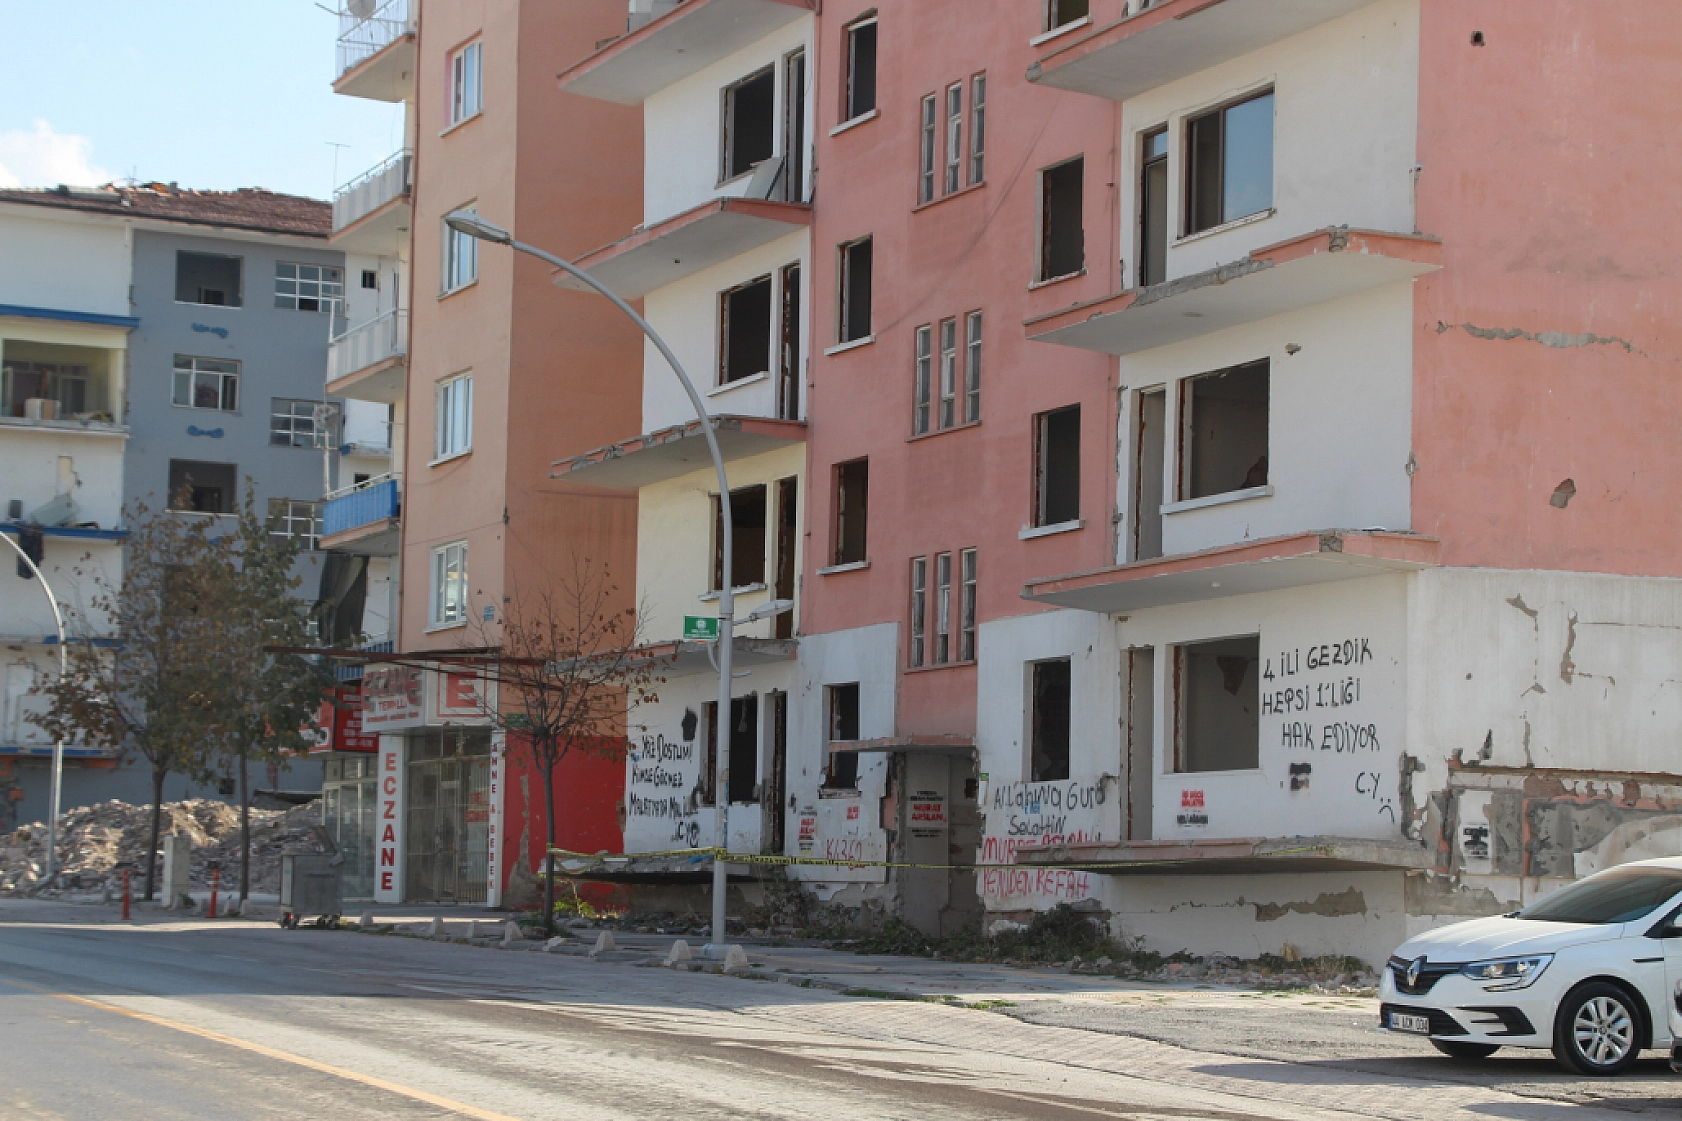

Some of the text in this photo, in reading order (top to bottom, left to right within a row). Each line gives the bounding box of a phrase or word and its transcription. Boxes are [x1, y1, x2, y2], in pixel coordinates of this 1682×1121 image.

[1263, 658, 1276, 682] 4
[1281, 721, 1315, 751] HAK
[380, 752, 398, 892] ECZANE
[1035, 868, 1091, 898] REFAH
